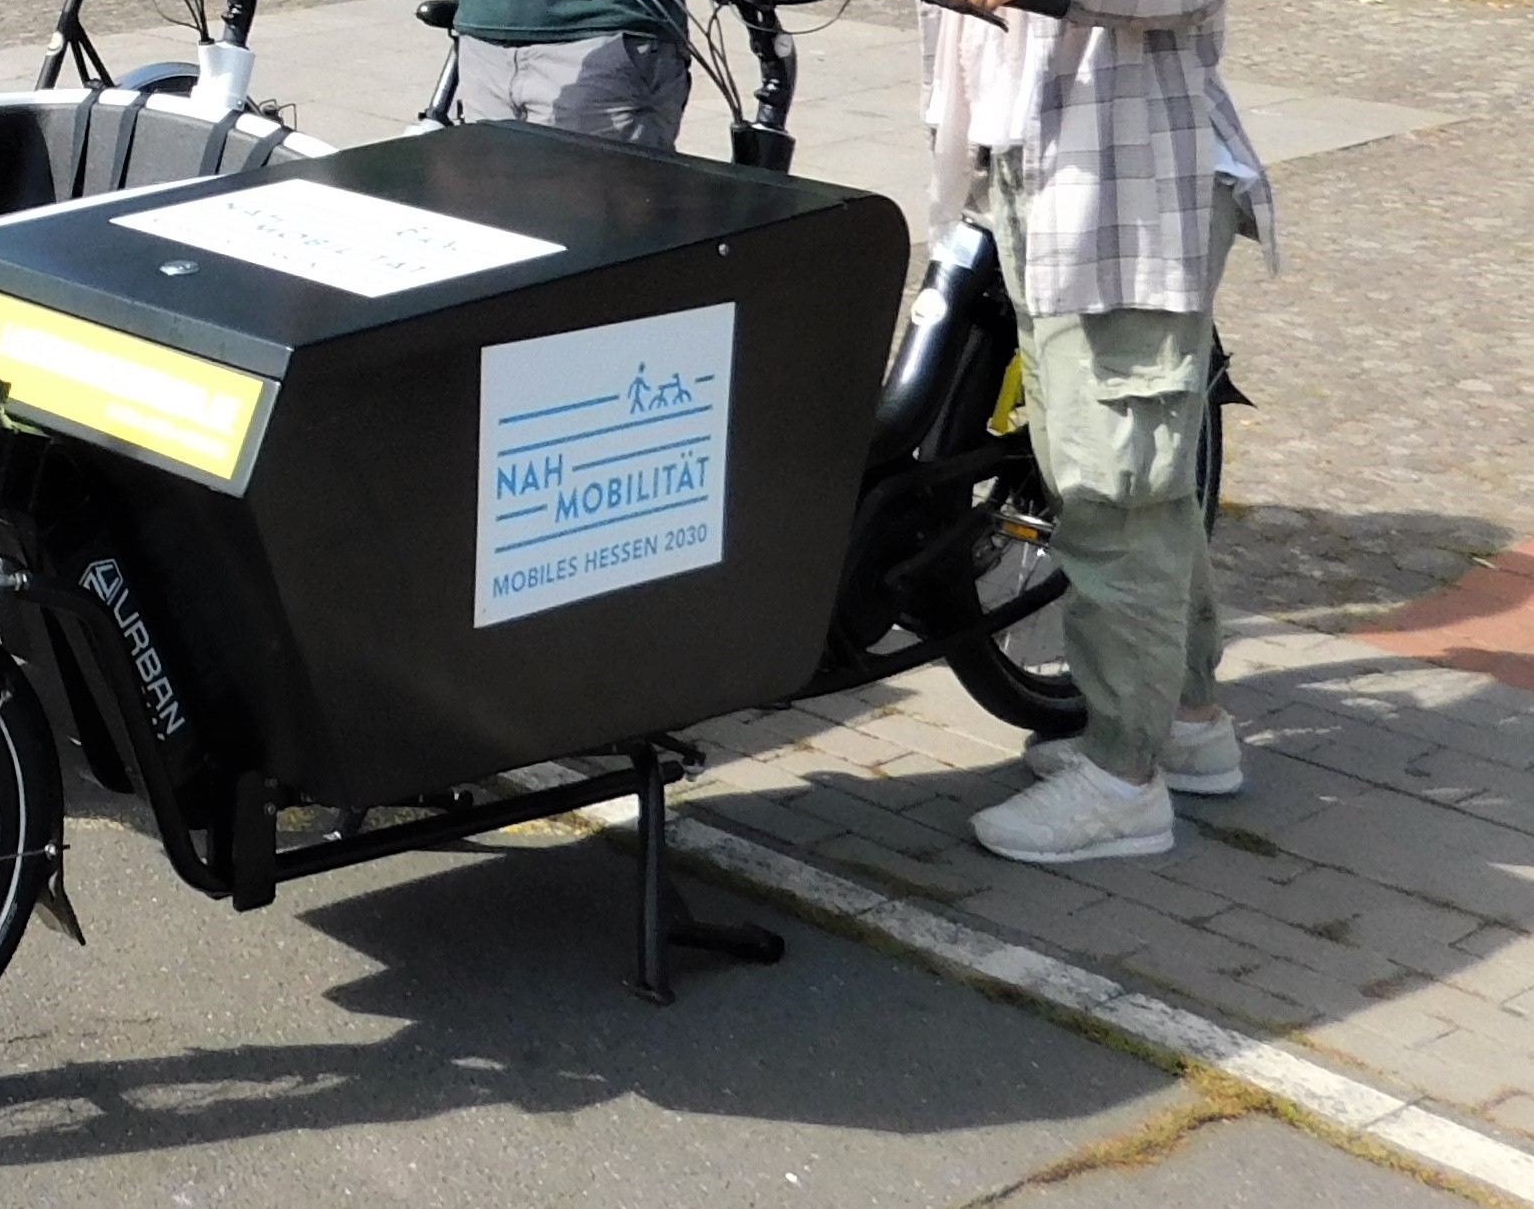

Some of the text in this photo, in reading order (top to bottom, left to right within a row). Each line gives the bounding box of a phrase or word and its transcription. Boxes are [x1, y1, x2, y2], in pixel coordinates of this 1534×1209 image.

[496, 454, 564, 500] NAH
[554, 452, 710, 524] MOBILITÄT
[492, 523, 708, 599] MOBILES HESSEN 2030
[112, 588, 186, 735] URBAN
